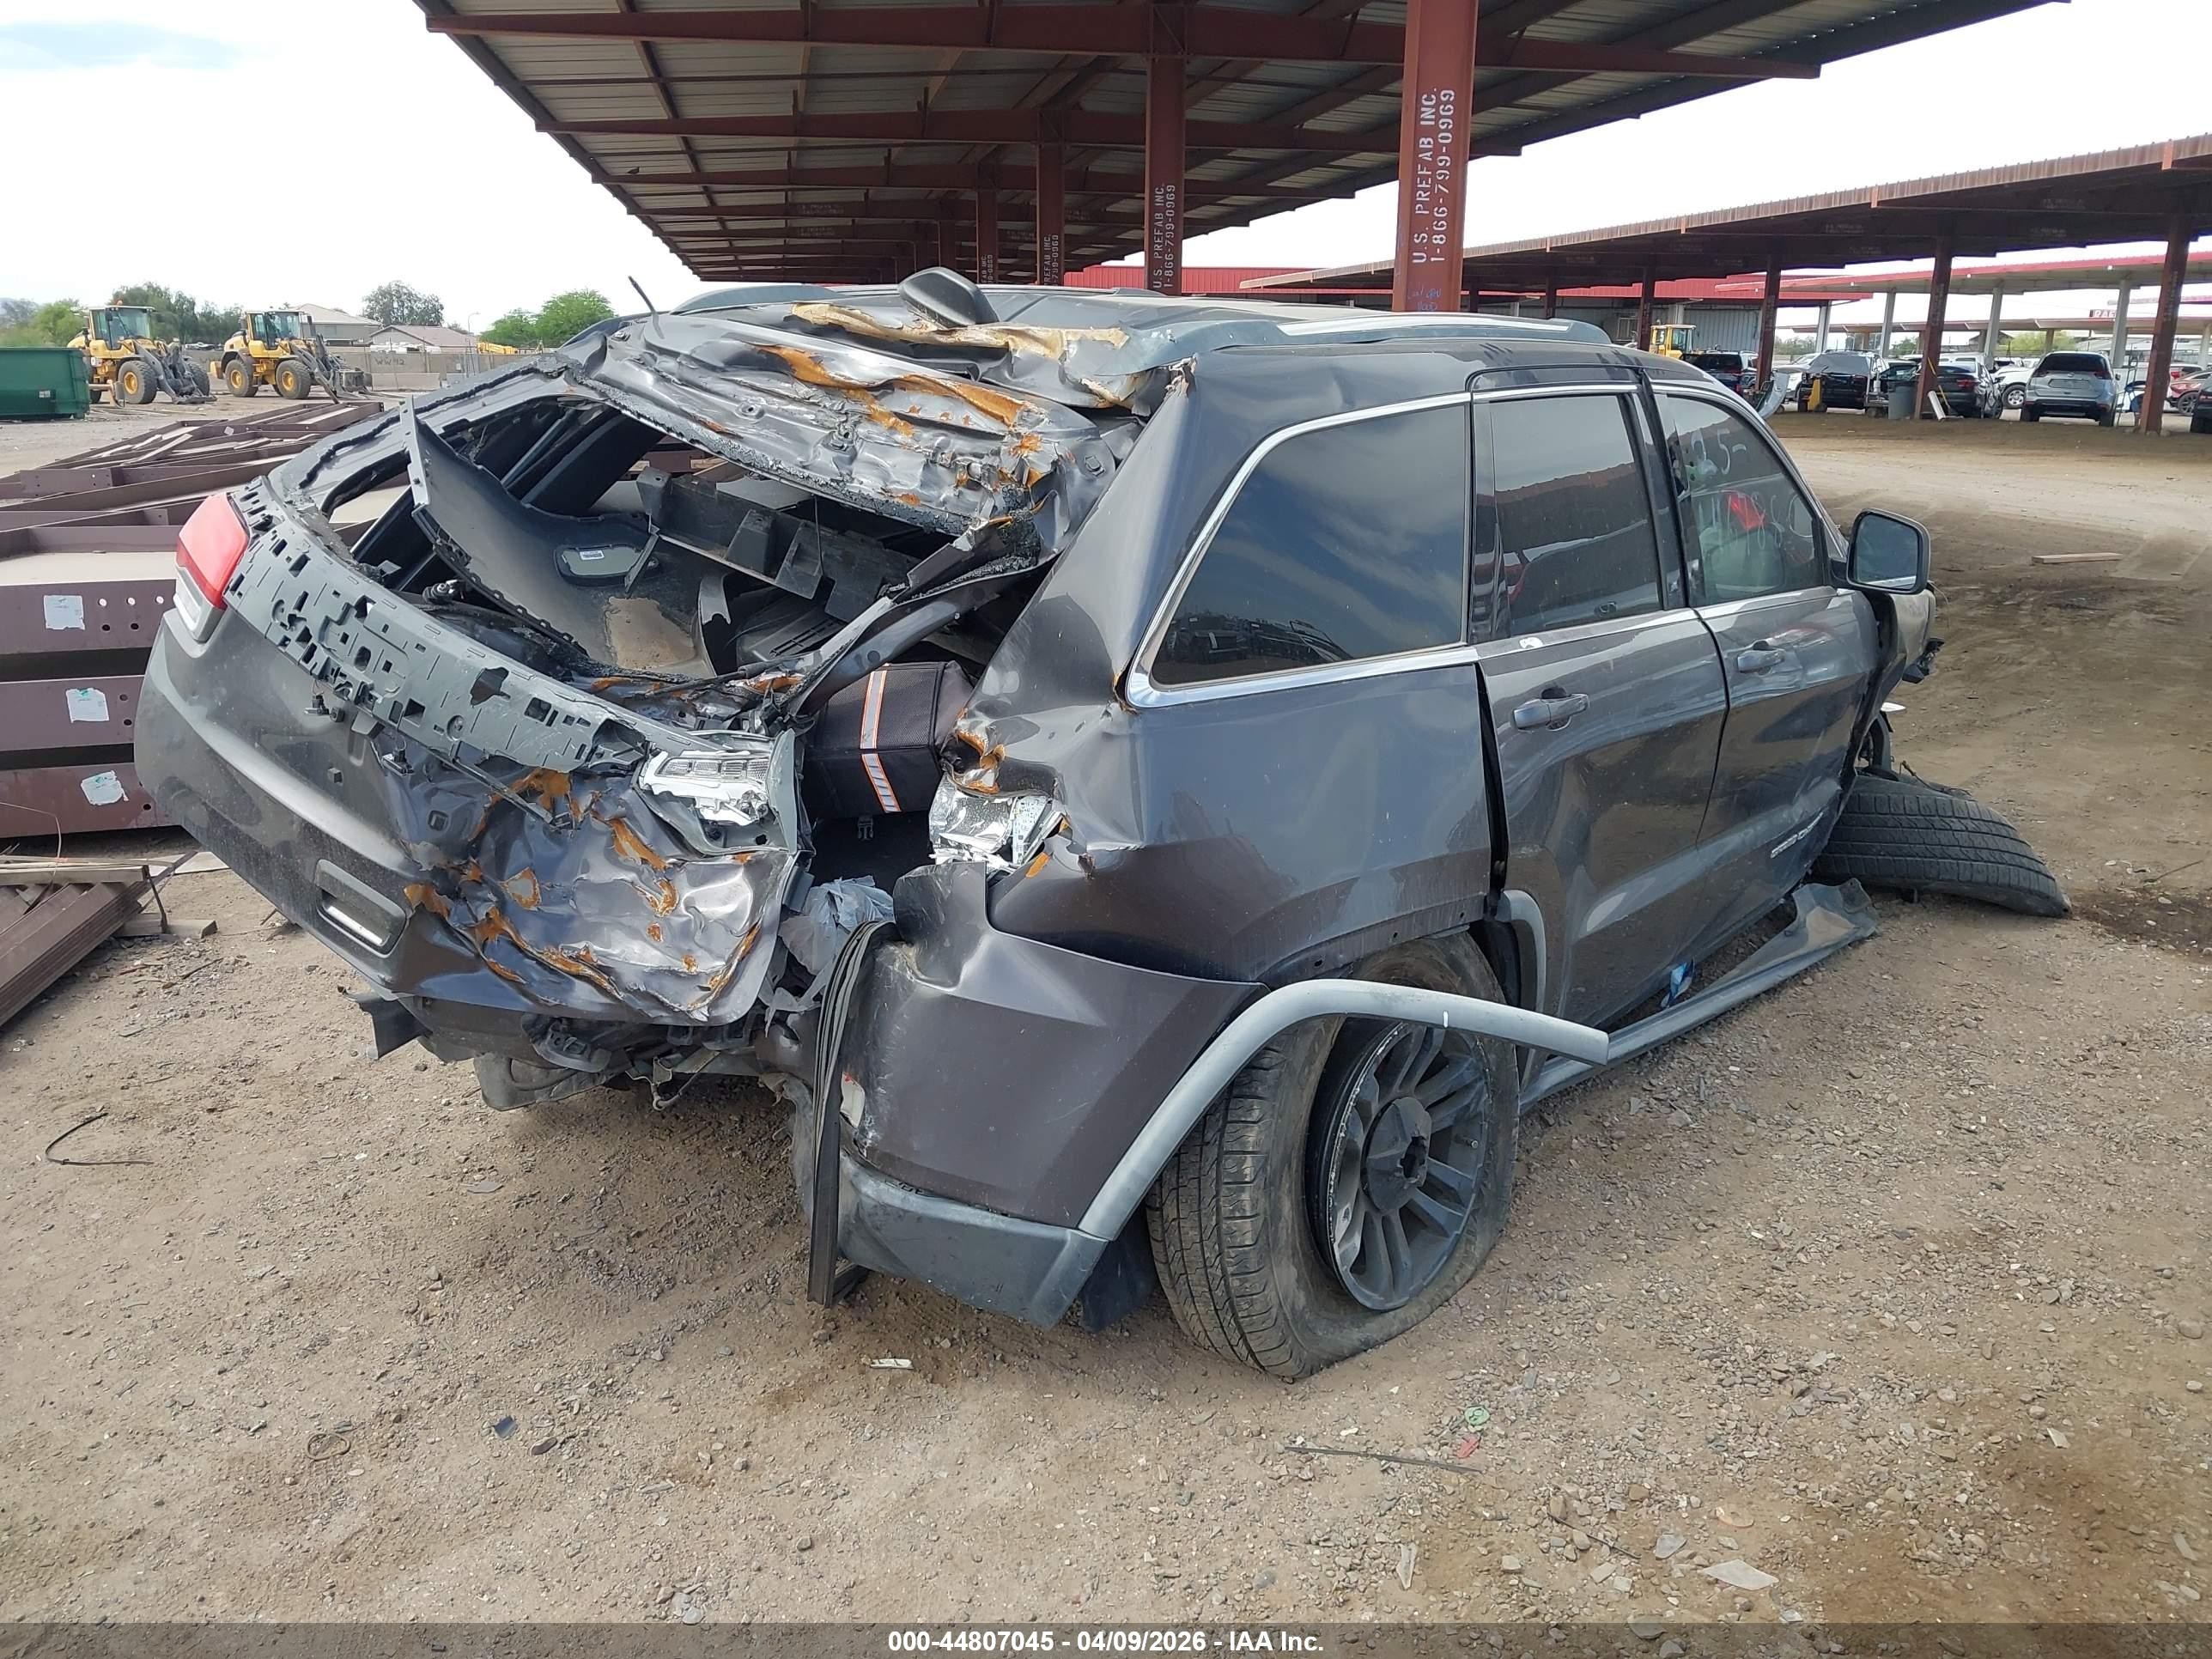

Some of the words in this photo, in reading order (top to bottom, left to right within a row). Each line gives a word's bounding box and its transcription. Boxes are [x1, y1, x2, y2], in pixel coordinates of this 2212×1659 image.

[1419, 88, 1437, 125] INC.
[1415, 137, 1434, 215] PREFAB
[1431, 89, 1455, 262] 1-866-799-0969
[1154, 184, 1164, 206] INC.
[1153, 212, 1164, 258] PREFAB
[1413, 226, 1429, 264] U.S.
[1153, 266, 1163, 289] U.S.
